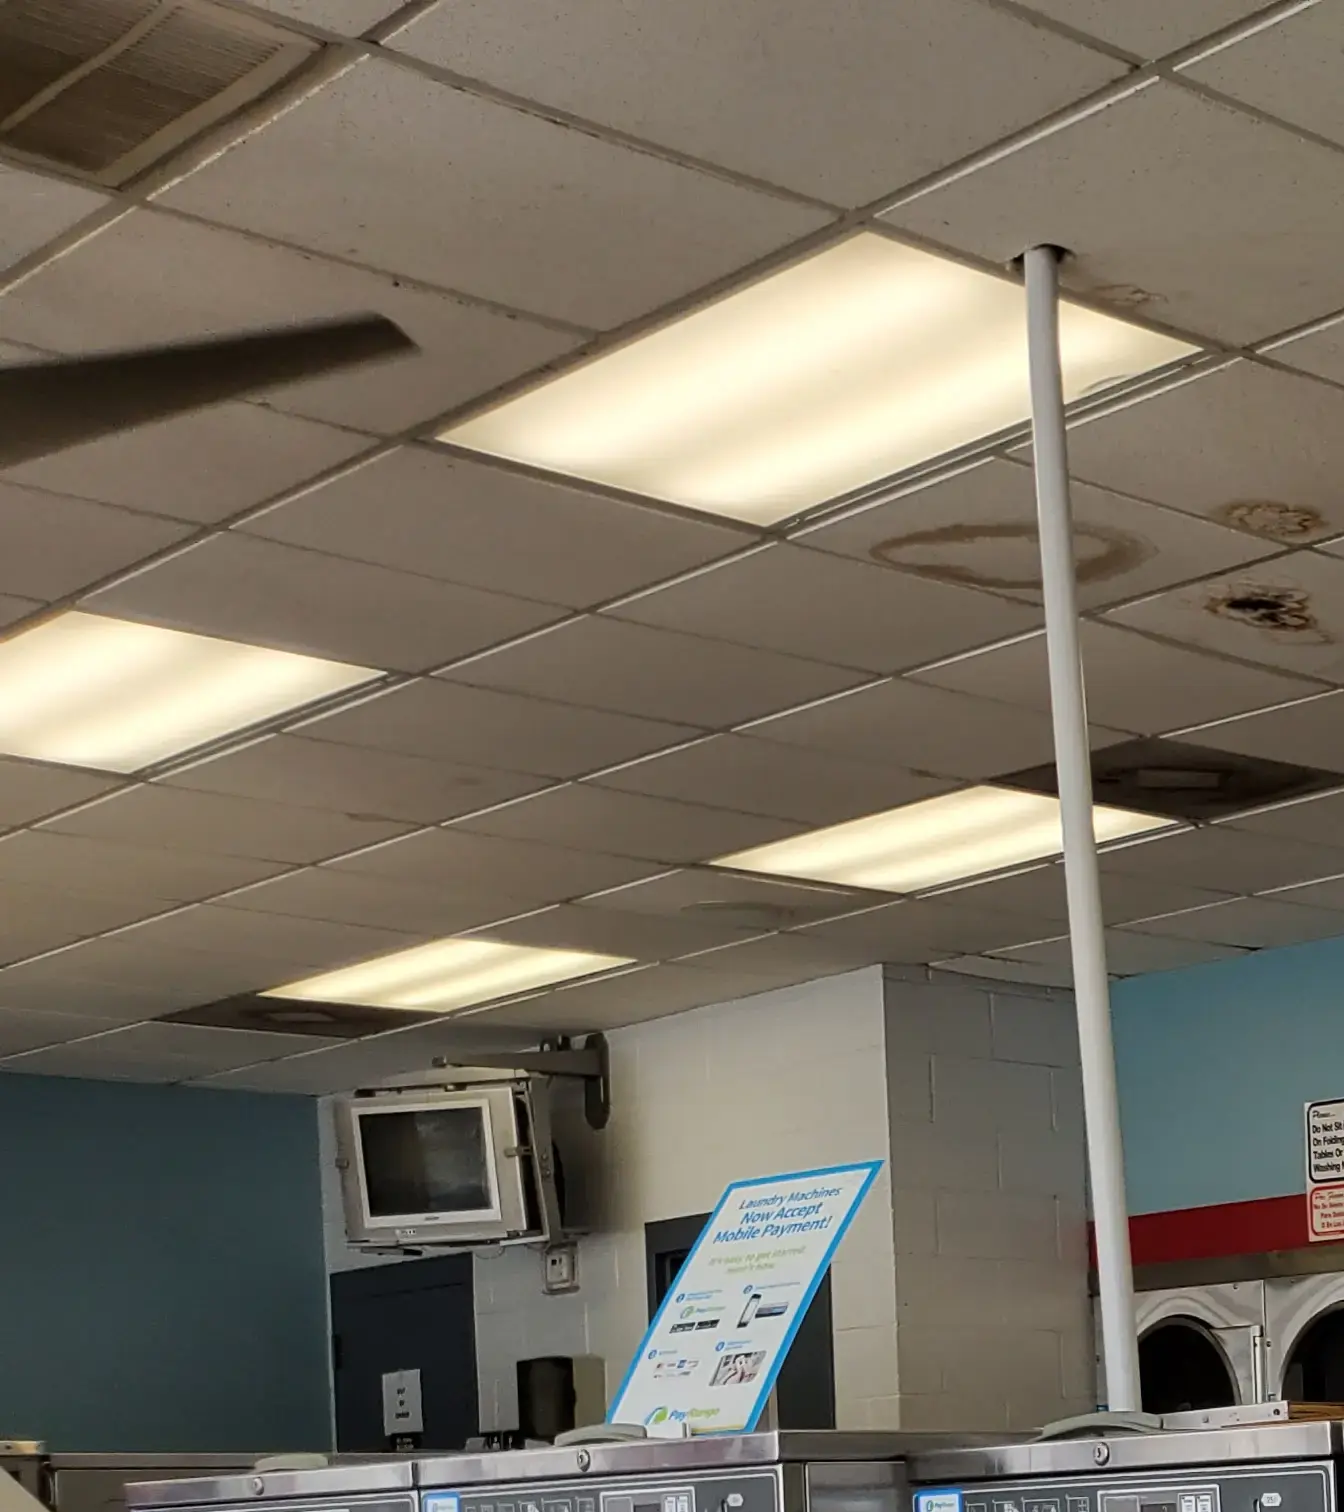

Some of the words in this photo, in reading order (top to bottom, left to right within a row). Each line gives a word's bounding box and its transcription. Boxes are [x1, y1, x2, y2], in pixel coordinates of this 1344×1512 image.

[1312, 1124, 1321, 1134] Do
[1322, 1123, 1334, 1133] Not
[1334, 1121, 1342, 1131] Sit
[1312, 1137, 1321, 1147] On
[1323, 1135, 1344, 1145] Folding
[1313, 1150, 1334, 1160] Tables
[1335, 1148, 1343, 1158] Or
[1313, 1162, 1340, 1173] Washing
[739, 1193, 787, 1210] Laundry
[788, 1186, 842, 1204] Machines
[741, 1210, 774, 1225] Now
[775, 1201, 823, 1221] Accept
[713, 1226, 761, 1245] Mobile
[763, 1216, 832, 1238] Payment!
